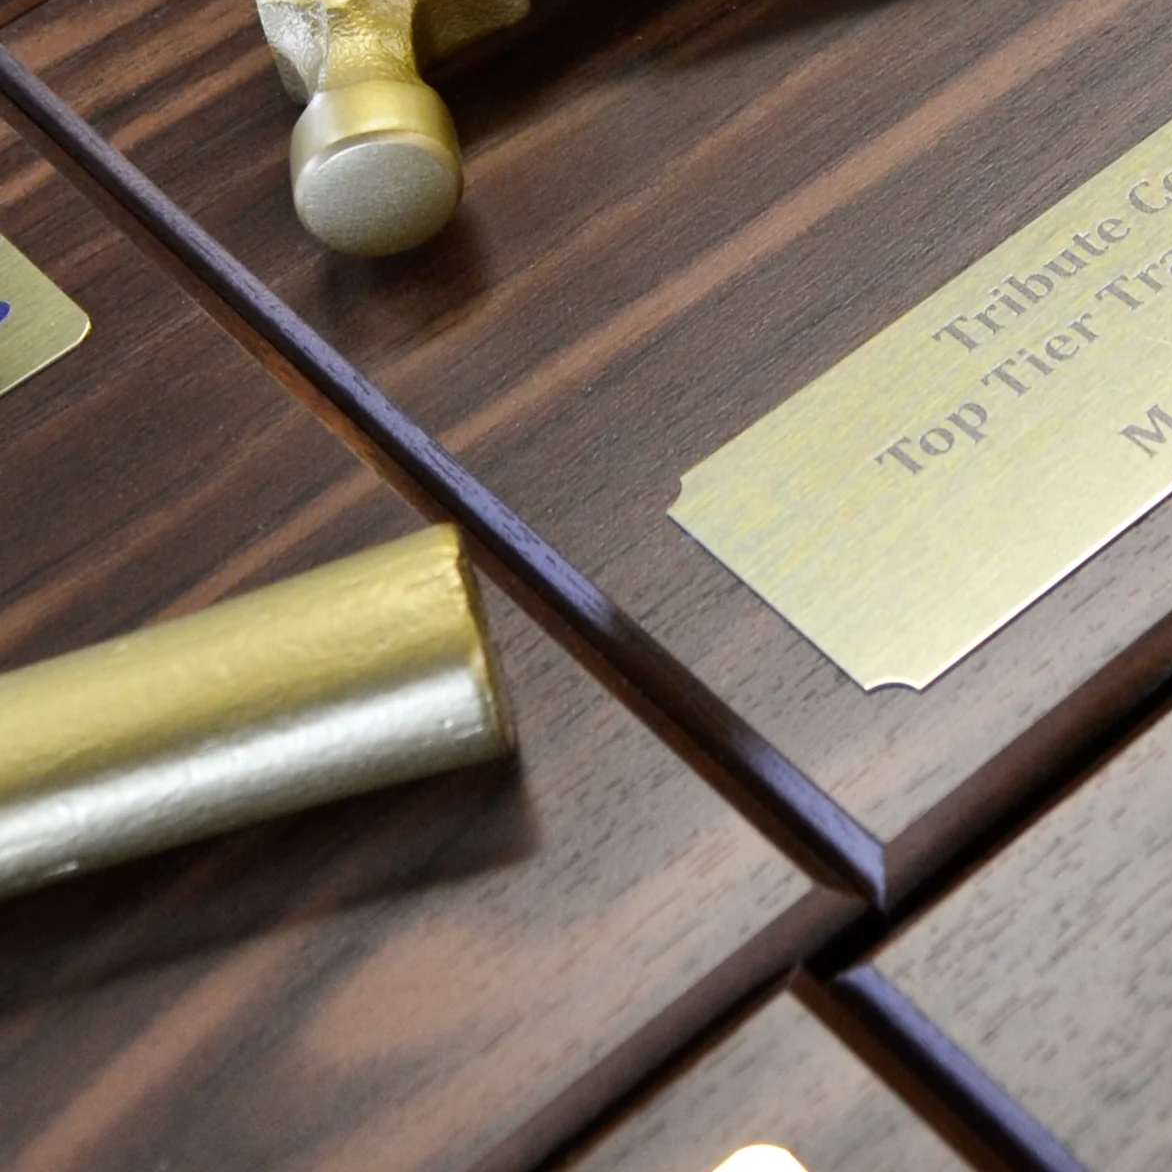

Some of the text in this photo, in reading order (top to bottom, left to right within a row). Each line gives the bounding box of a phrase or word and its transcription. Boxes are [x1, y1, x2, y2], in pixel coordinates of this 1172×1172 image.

[932, 210, 1132, 354] Tribute
[874, 403, 988, 480] Top
[981, 312, 1101, 402] Tier
